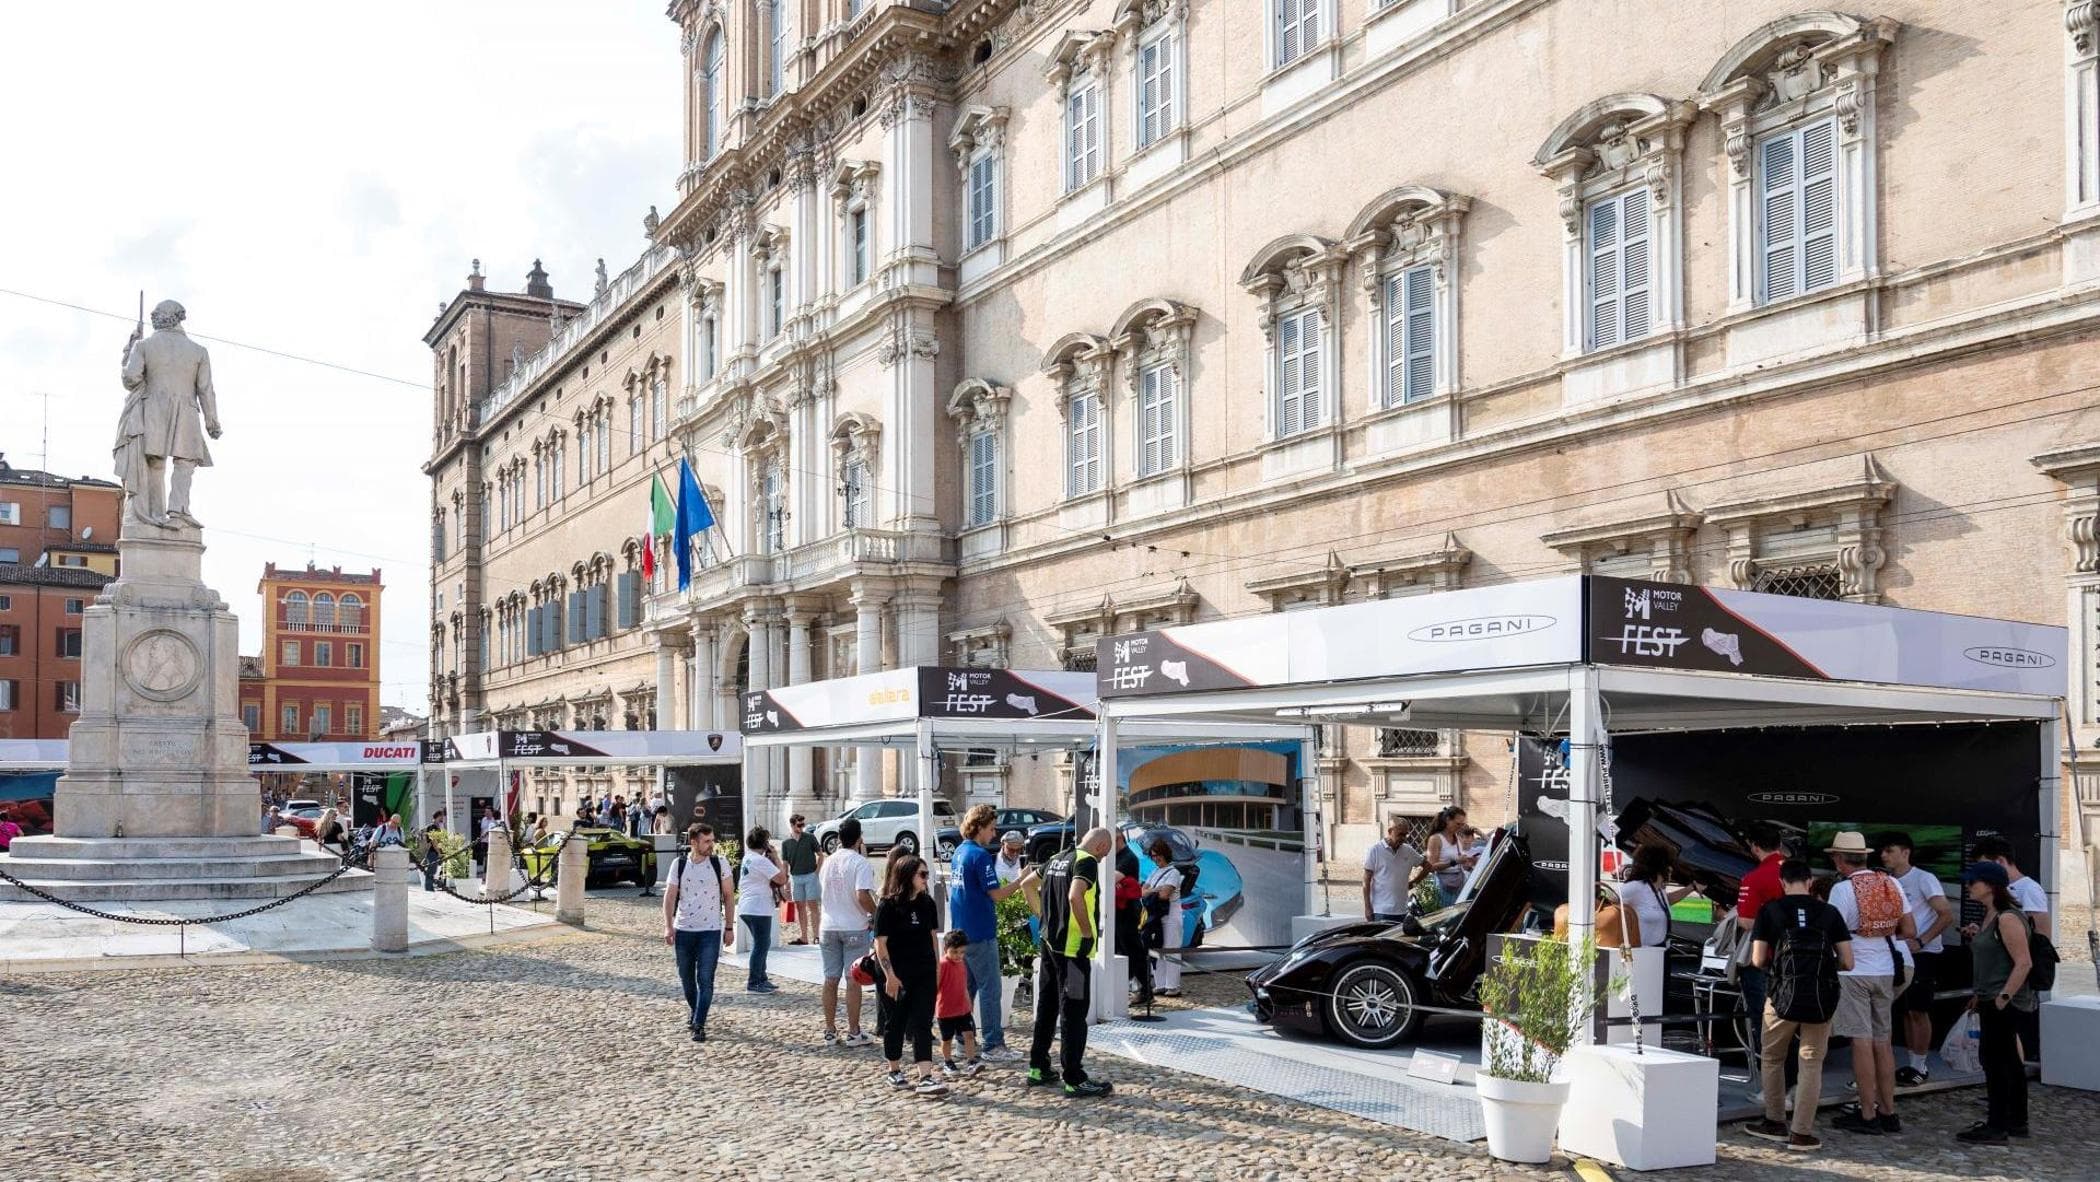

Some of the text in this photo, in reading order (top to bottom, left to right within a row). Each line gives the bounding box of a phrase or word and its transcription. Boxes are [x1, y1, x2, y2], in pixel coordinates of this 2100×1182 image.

[1653, 590, 1682, 601] MOTOR
[1653, 601, 1679, 612] VALLEY
[1431, 618, 1530, 639] PAGANI
[1621, 624, 1682, 657] FEST
[1980, 650, 2042, 665] PAGANI
[1113, 665, 1149, 689] FEST
[946, 694, 991, 712] FEST
[363, 747, 415, 759] DUCATI
[514, 744, 544, 755] FEST
[1762, 794, 1825, 804] PAGANI
[1541, 862, 1570, 870] PAGA
